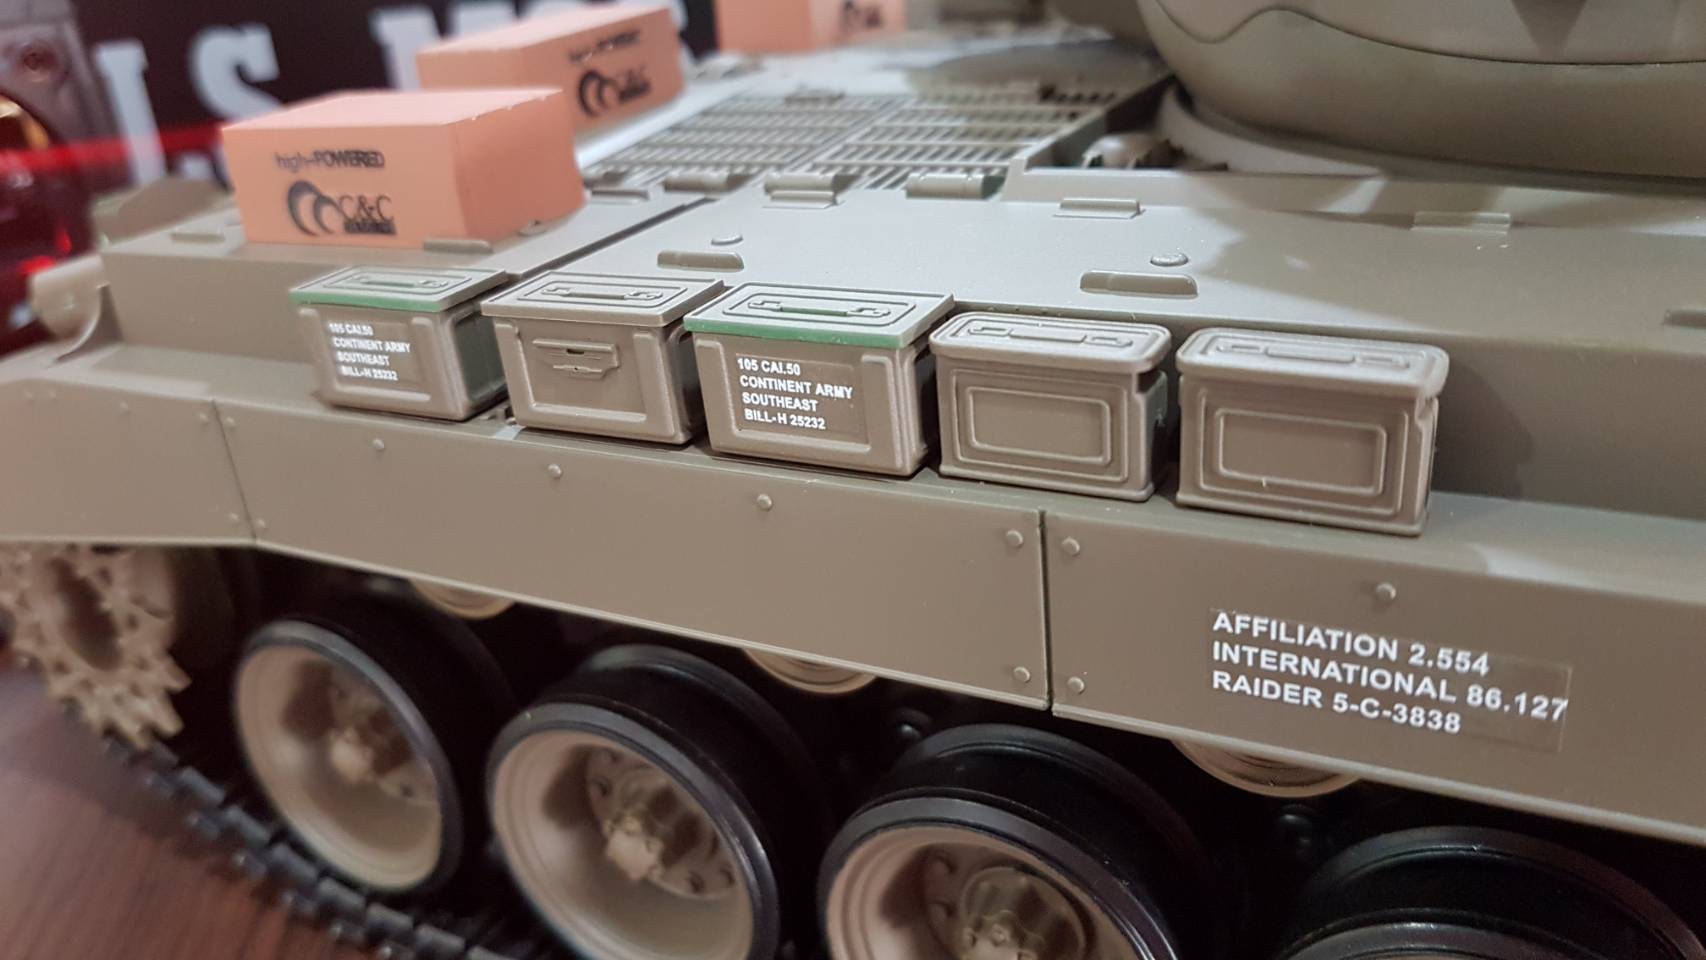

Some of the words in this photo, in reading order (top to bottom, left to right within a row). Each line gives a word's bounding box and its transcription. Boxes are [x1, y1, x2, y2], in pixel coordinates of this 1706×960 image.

[333, 337, 384, 351] CONTINENT
[385, 341, 411, 353] ARMY
[337, 351, 390, 365] SOUTHEAST
[737, 358, 759, 371] 105
[374, 369, 398, 381] 25232
[740, 375, 811, 394] CONTINENT
[815, 383, 853, 399] ARMY
[742, 392, 818, 412] SOUTHEAST
[744, 409, 787, 425] BILL-H
[790, 414, 826, 430] 25232
[1213, 612, 1398, 662] AFFILIATION
[1408, 643, 1490, 676] 2.554
[1213, 641, 1457, 703] INTERNATIONAL
[1466, 684, 1569, 722] 86.127
[1213, 670, 1323, 708] RAIDER
[1332, 692, 1461, 734] 5-C-3838
